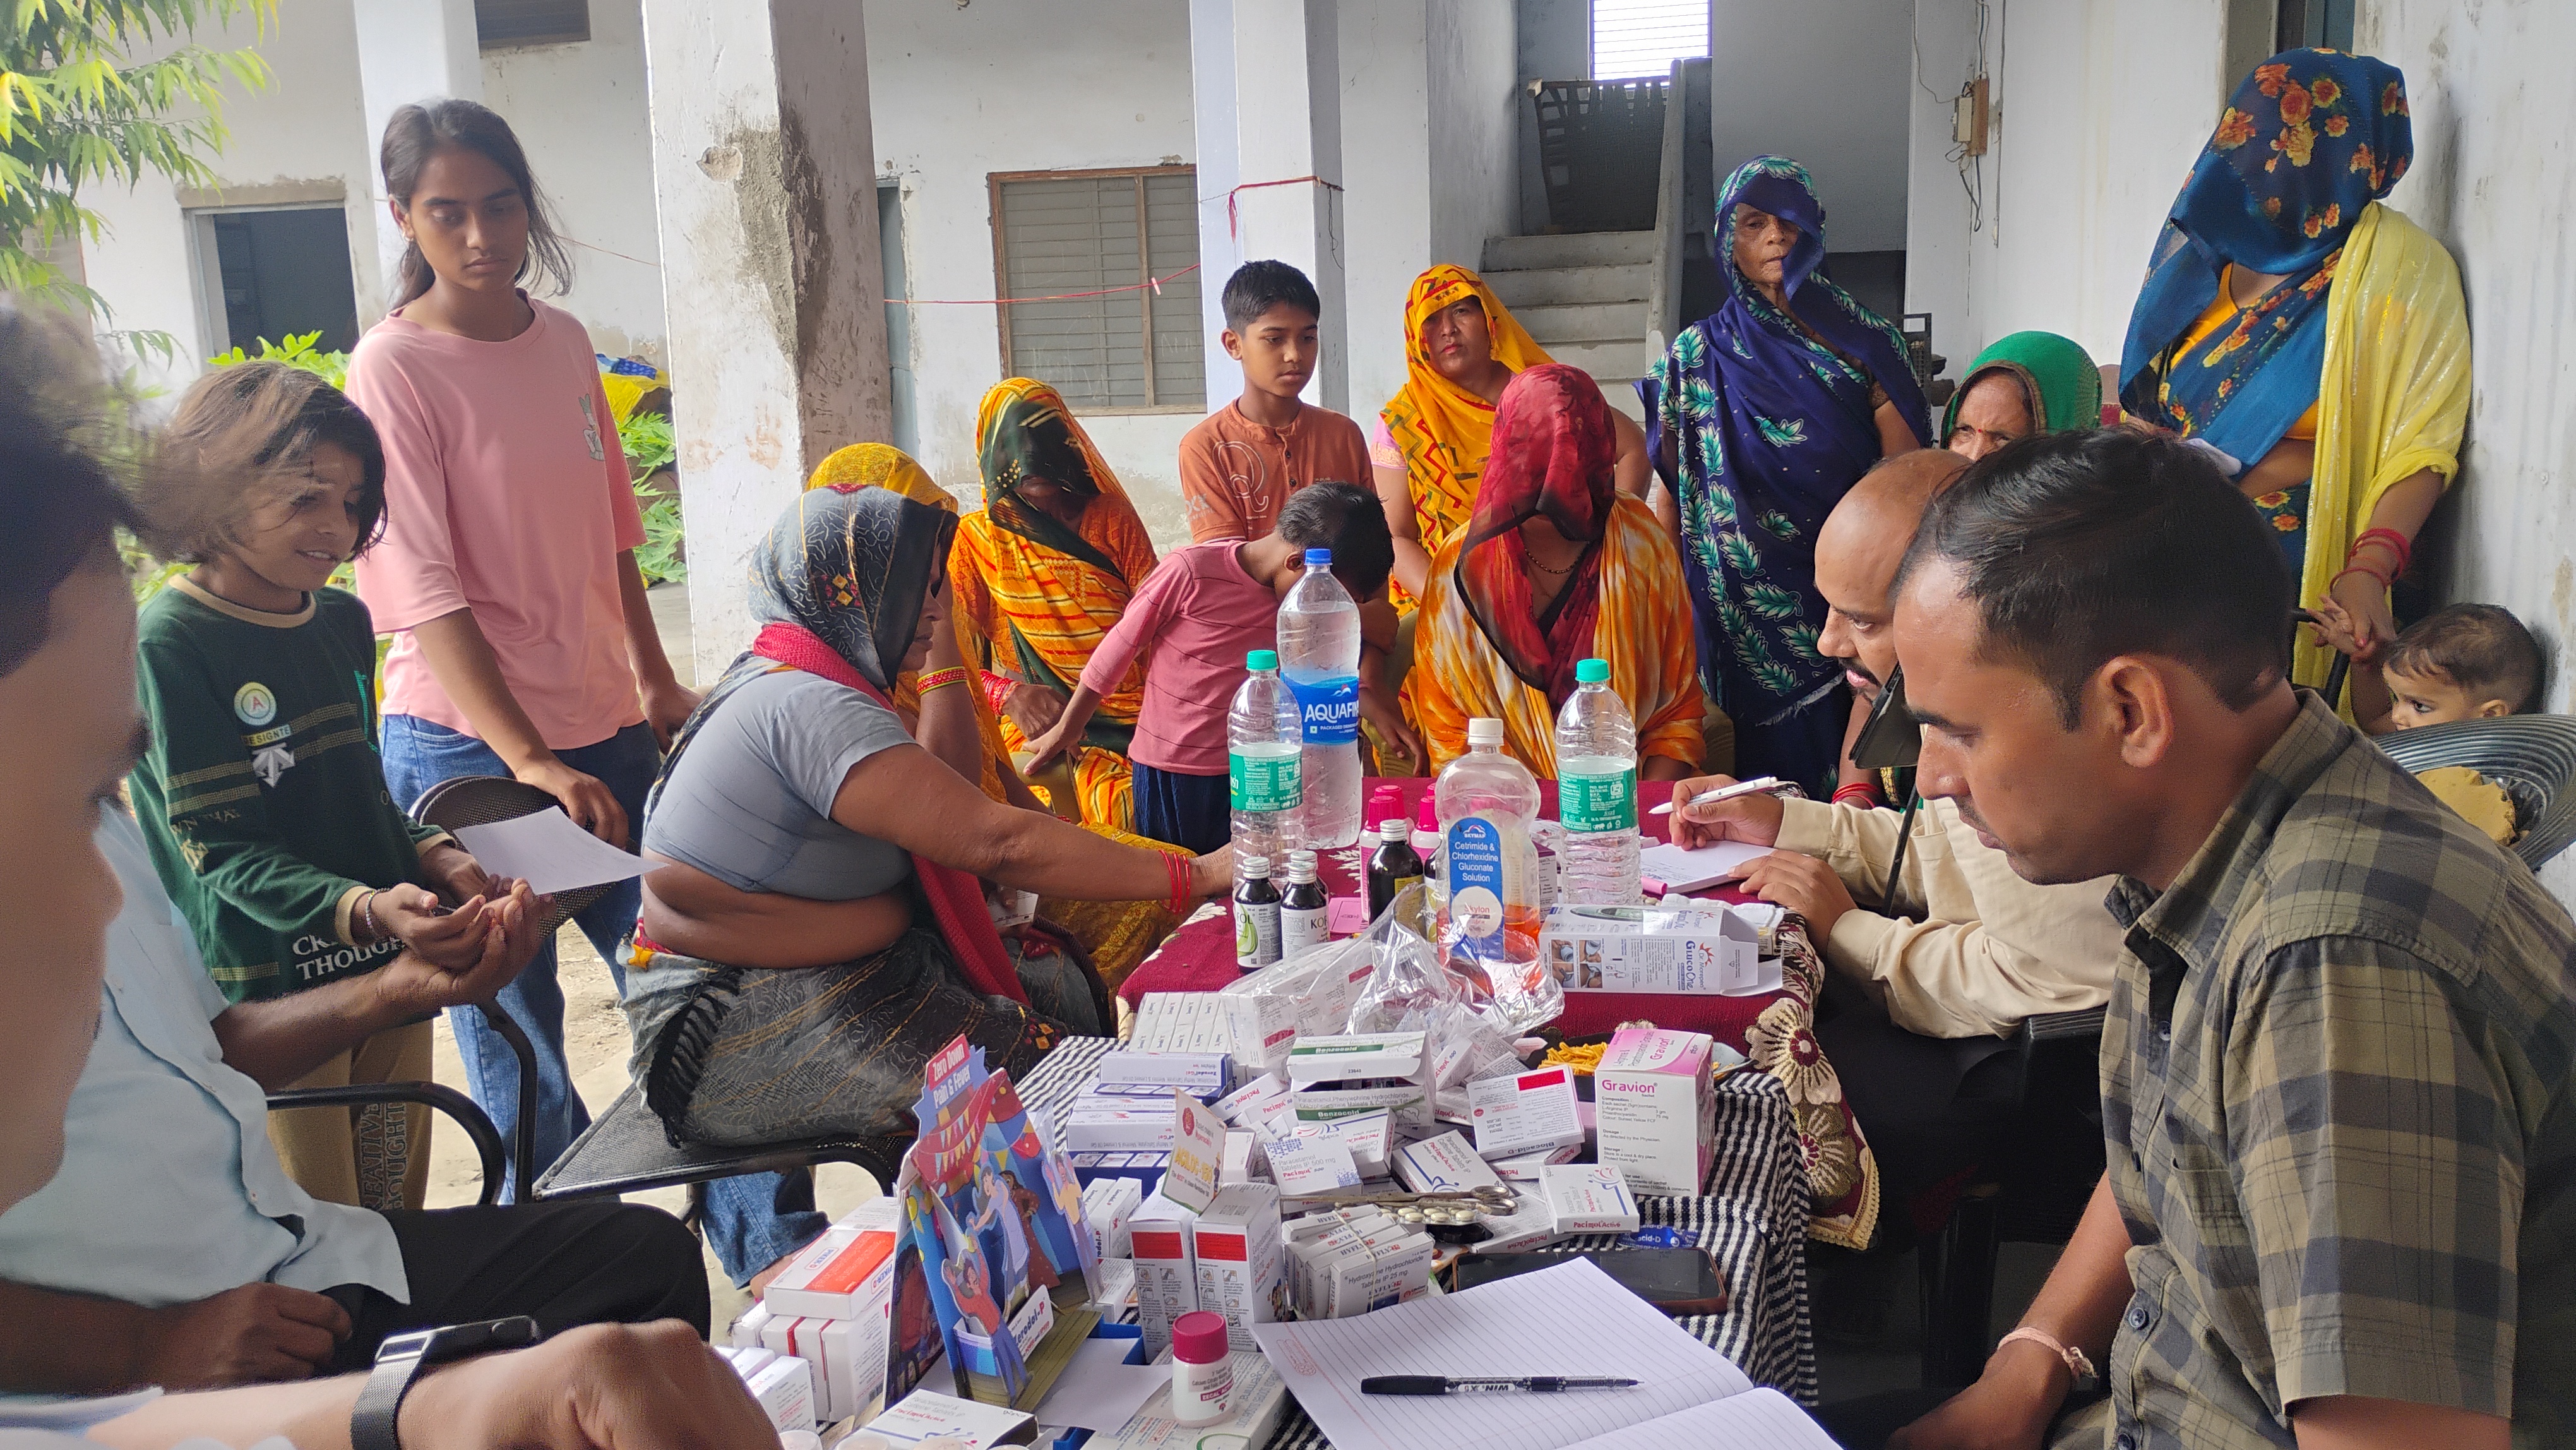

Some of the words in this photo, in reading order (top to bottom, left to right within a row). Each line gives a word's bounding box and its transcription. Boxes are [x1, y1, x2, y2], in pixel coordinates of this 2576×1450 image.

[1455, 841, 1488, 851] Cetrimide
[1489, 842, 1495, 851] &
[1452, 851, 1499, 862] Chlorhexidine
[1458, 861, 1494, 872] Gluconate
[1462, 873, 1491, 882] Solution
[933, 1057, 947, 1082] Zero
[946, 1043, 965, 1070] Down
[933, 1084, 949, 1110] Pain
[948, 1077, 955, 1096] &
[953, 1064, 971, 1092] Fever
[1263, 1100, 1286, 1113] Pacimol
[1445, 1135, 1469, 1159] Paracetamol
[1279, 1154, 1316, 1166] Paracetamol
[1280, 1163, 1302, 1172] Tablets
[1311, 1158, 1325, 1166] 500
[1385, 1255, 1424, 1273] Hydrochloride
[1390, 1271, 1398, 1280] 25
